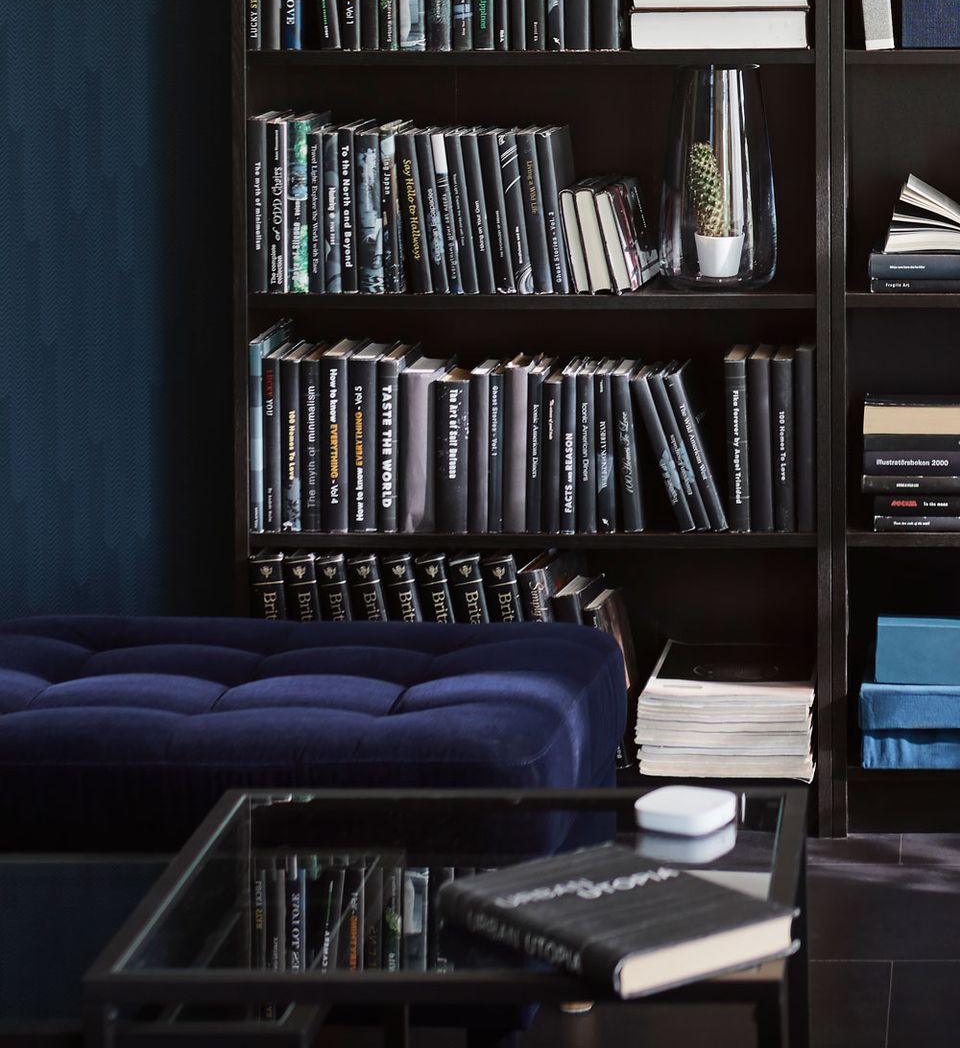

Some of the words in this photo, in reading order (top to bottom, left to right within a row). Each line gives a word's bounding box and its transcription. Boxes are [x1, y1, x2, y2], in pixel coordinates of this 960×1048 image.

[342, 146, 349, 157] To
[402, 159, 412, 175] Say
[342, 179, 351, 207] North
[406, 178, 415, 202] Hello
[344, 210, 352, 228] and
[409, 203, 416, 215] to
[343, 232, 352, 268] Beyond
[410, 217, 421, 260] Hallways
[330, 389, 337, 398] to
[382, 385, 392, 426] TASTE
[330, 424, 338, 479] EVERYTHING
[382, 430, 392, 455] THE
[564, 433, 573, 471] REASON
[732, 437, 739, 446] by
[732, 449, 741, 471] Angel
[330, 485, 338, 498] Vol
[382, 459, 392, 508] WORLD
[564, 484, 573, 513] FACTS
